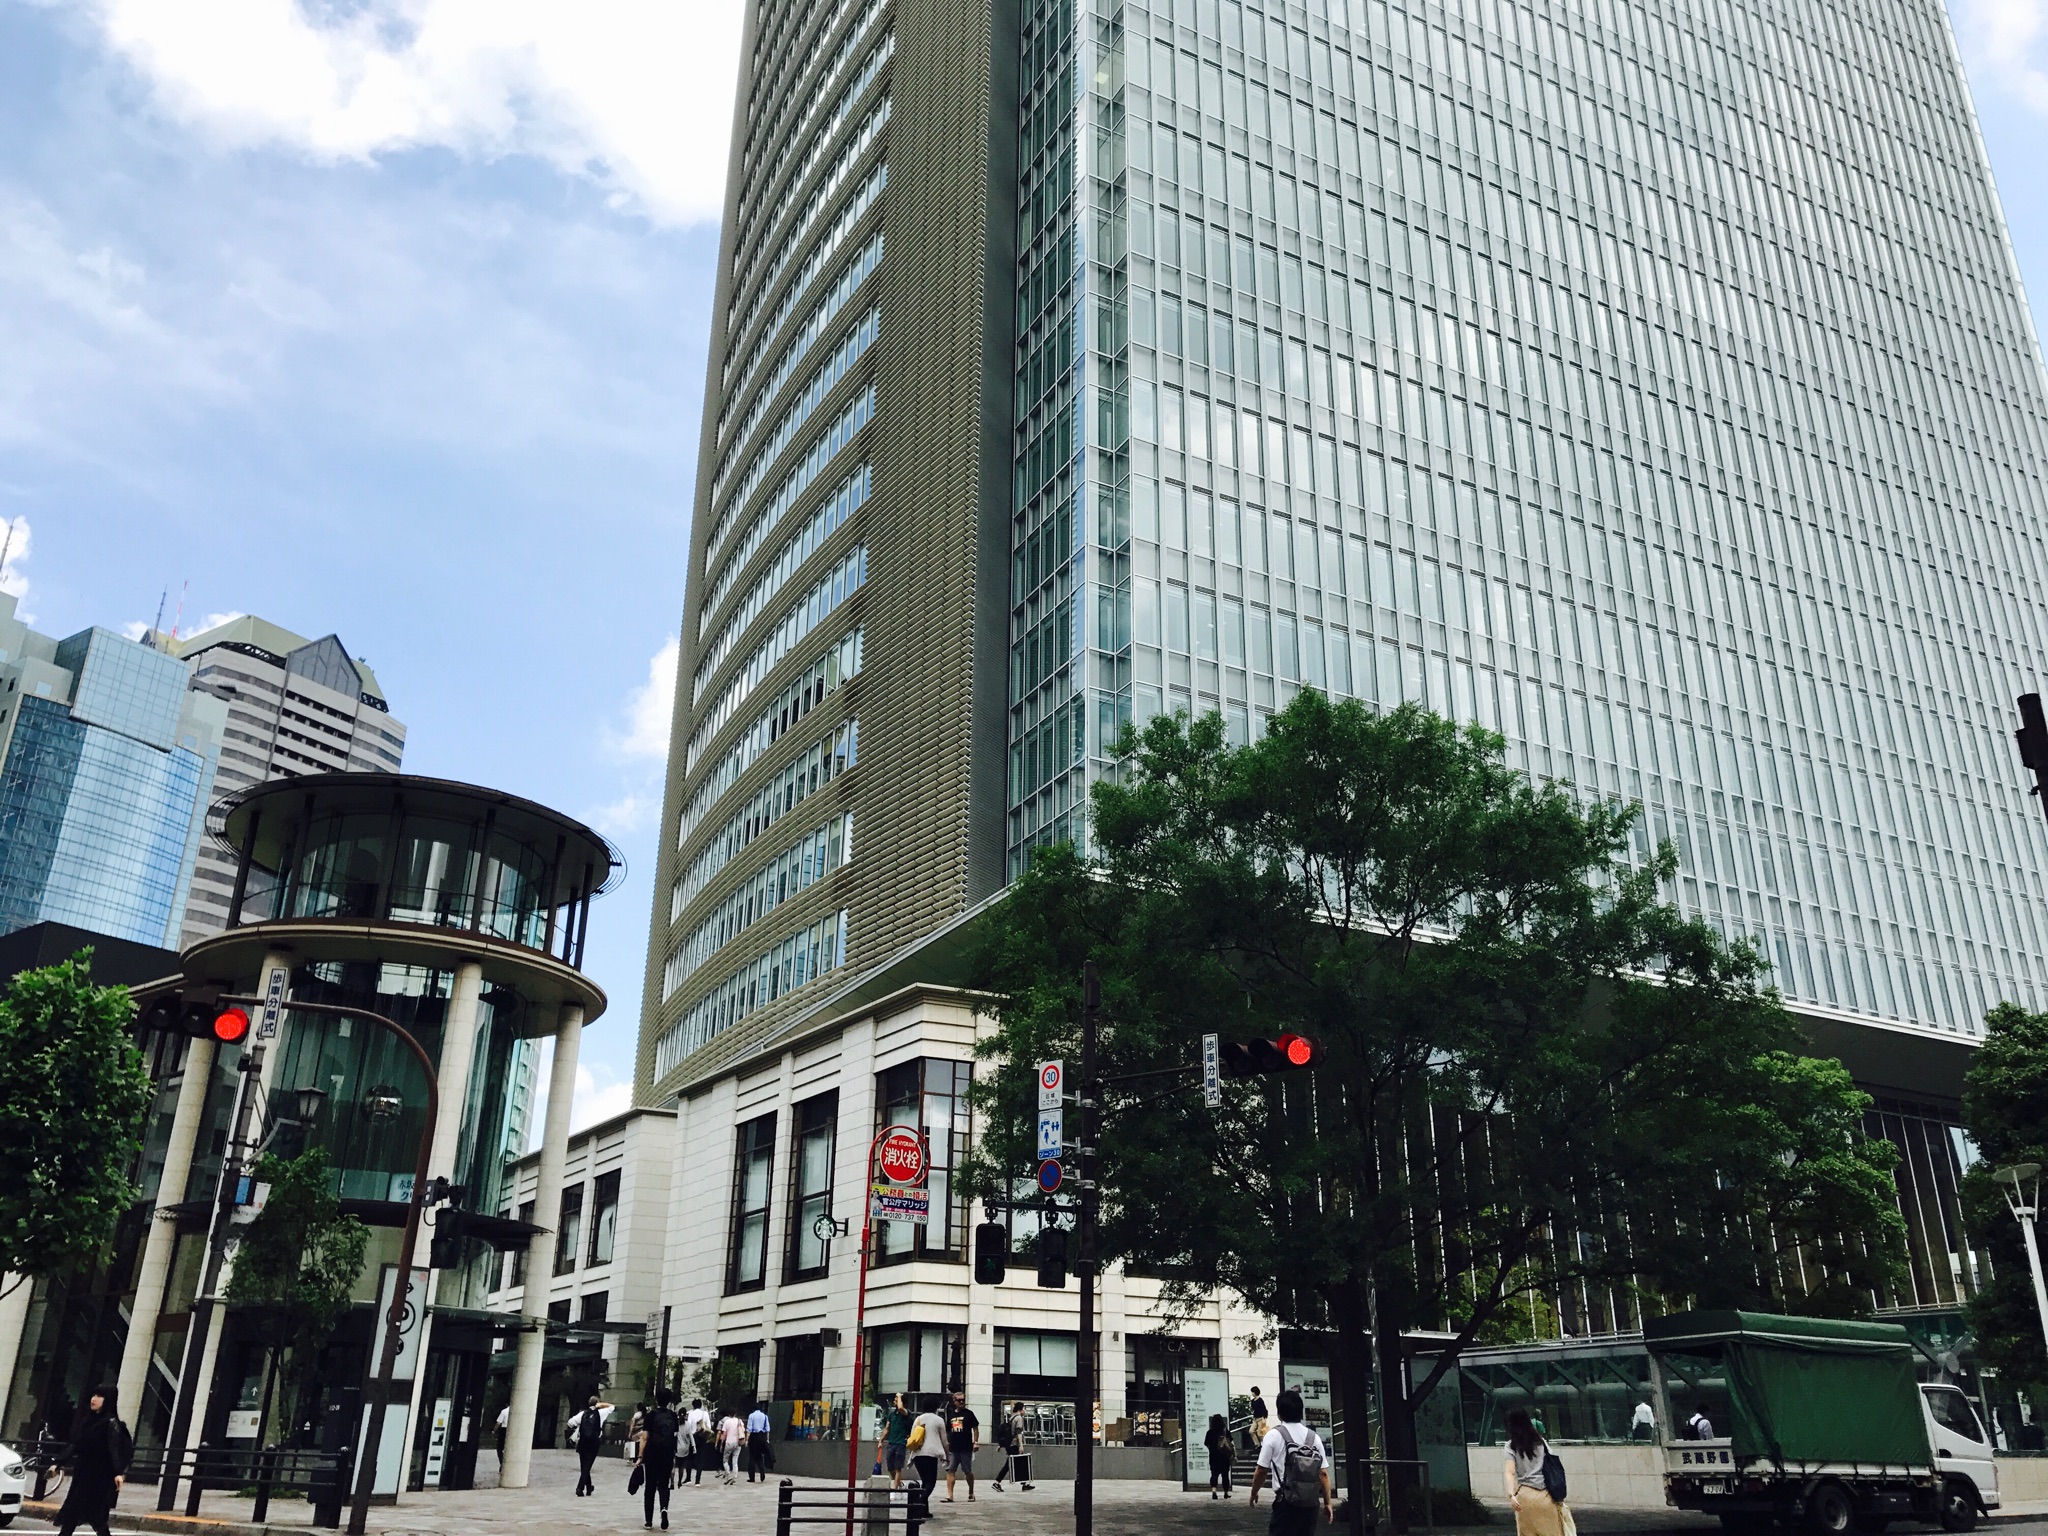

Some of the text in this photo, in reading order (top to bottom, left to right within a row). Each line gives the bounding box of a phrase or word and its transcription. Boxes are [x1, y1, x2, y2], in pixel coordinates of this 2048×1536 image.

[264, 974, 283, 1033] 歩車分離式
[1046, 1071, 1056, 1083] 30
[1206, 1041, 1217, 1101] 歩車分離式
[898, 1140, 916, 1148] HYDRANT
[884, 1147, 919, 1169] 消火栓
[1039, 1149, 1060, 1158] ゾーン30
[882, 1198, 927, 1209] 官公庁マリッジ
